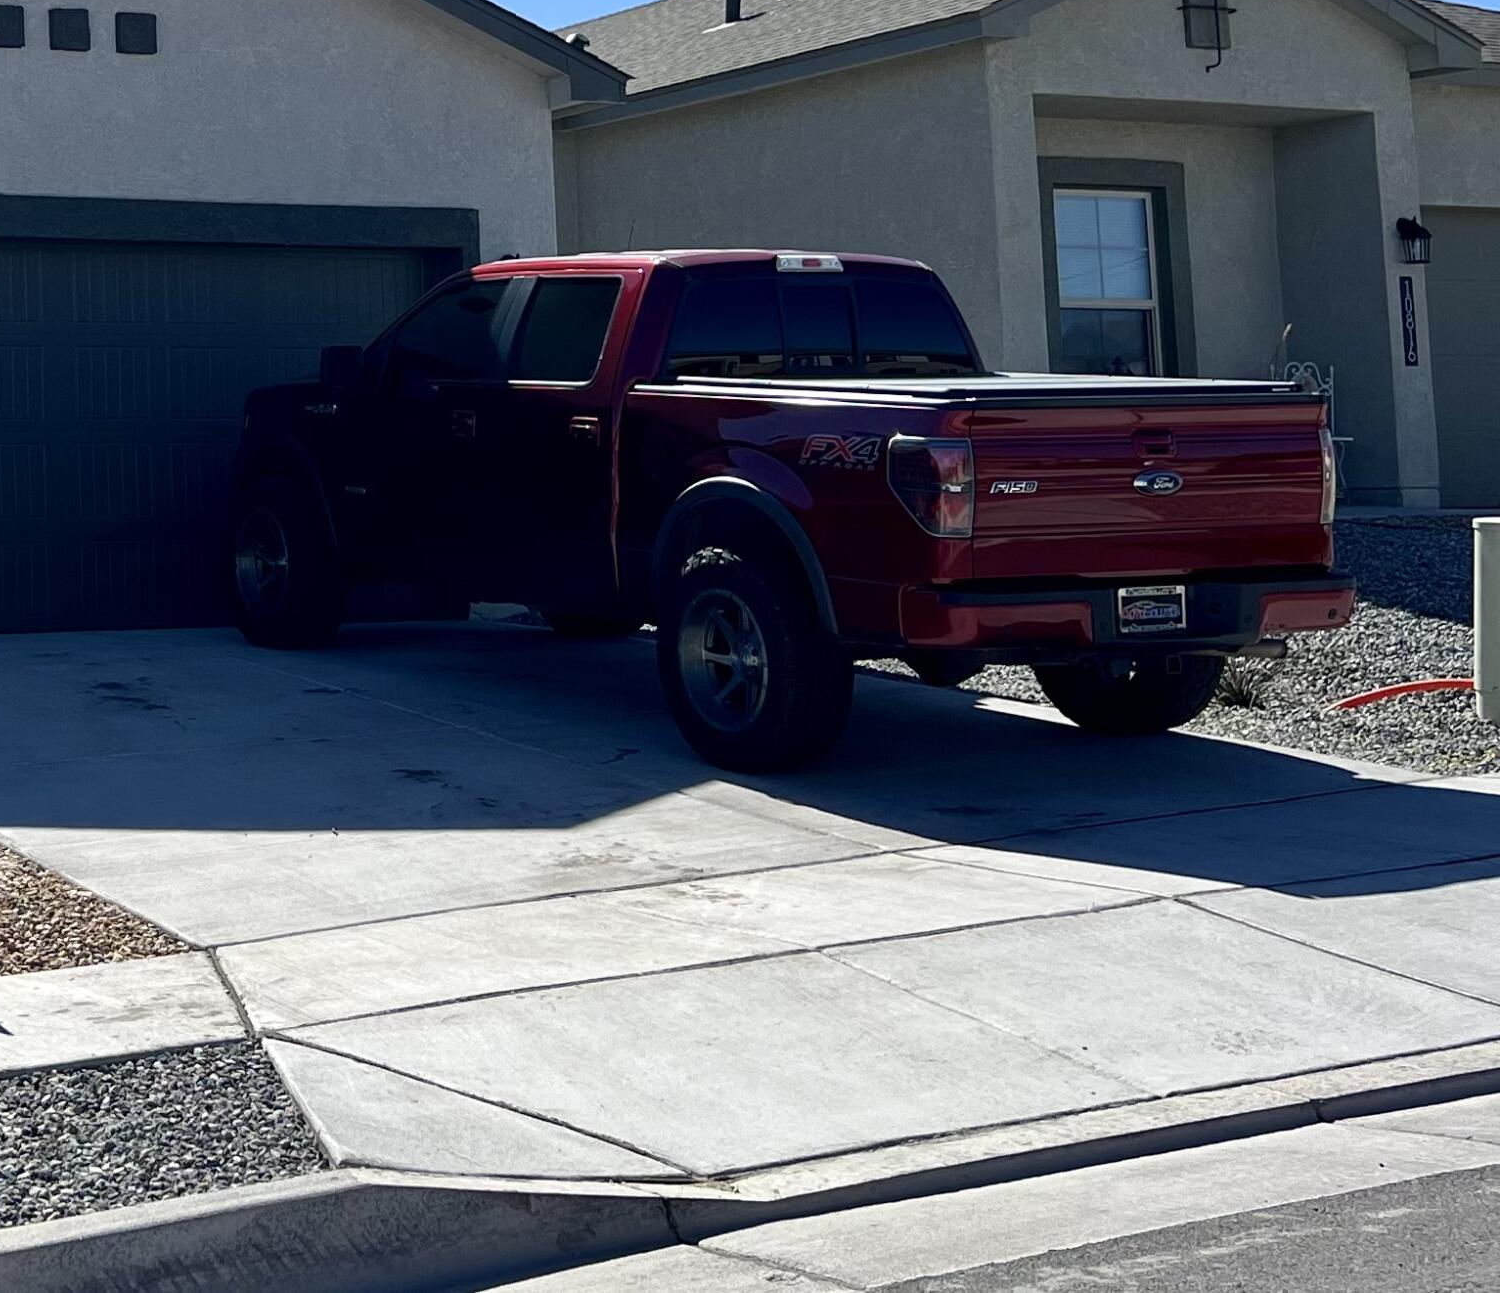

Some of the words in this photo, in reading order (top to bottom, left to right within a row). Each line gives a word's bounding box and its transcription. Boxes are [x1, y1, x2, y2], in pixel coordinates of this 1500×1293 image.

[1404, 280, 1417, 363] 10816
[801, 433, 882, 464] FX4
[1153, 476, 1176, 490] Ford
